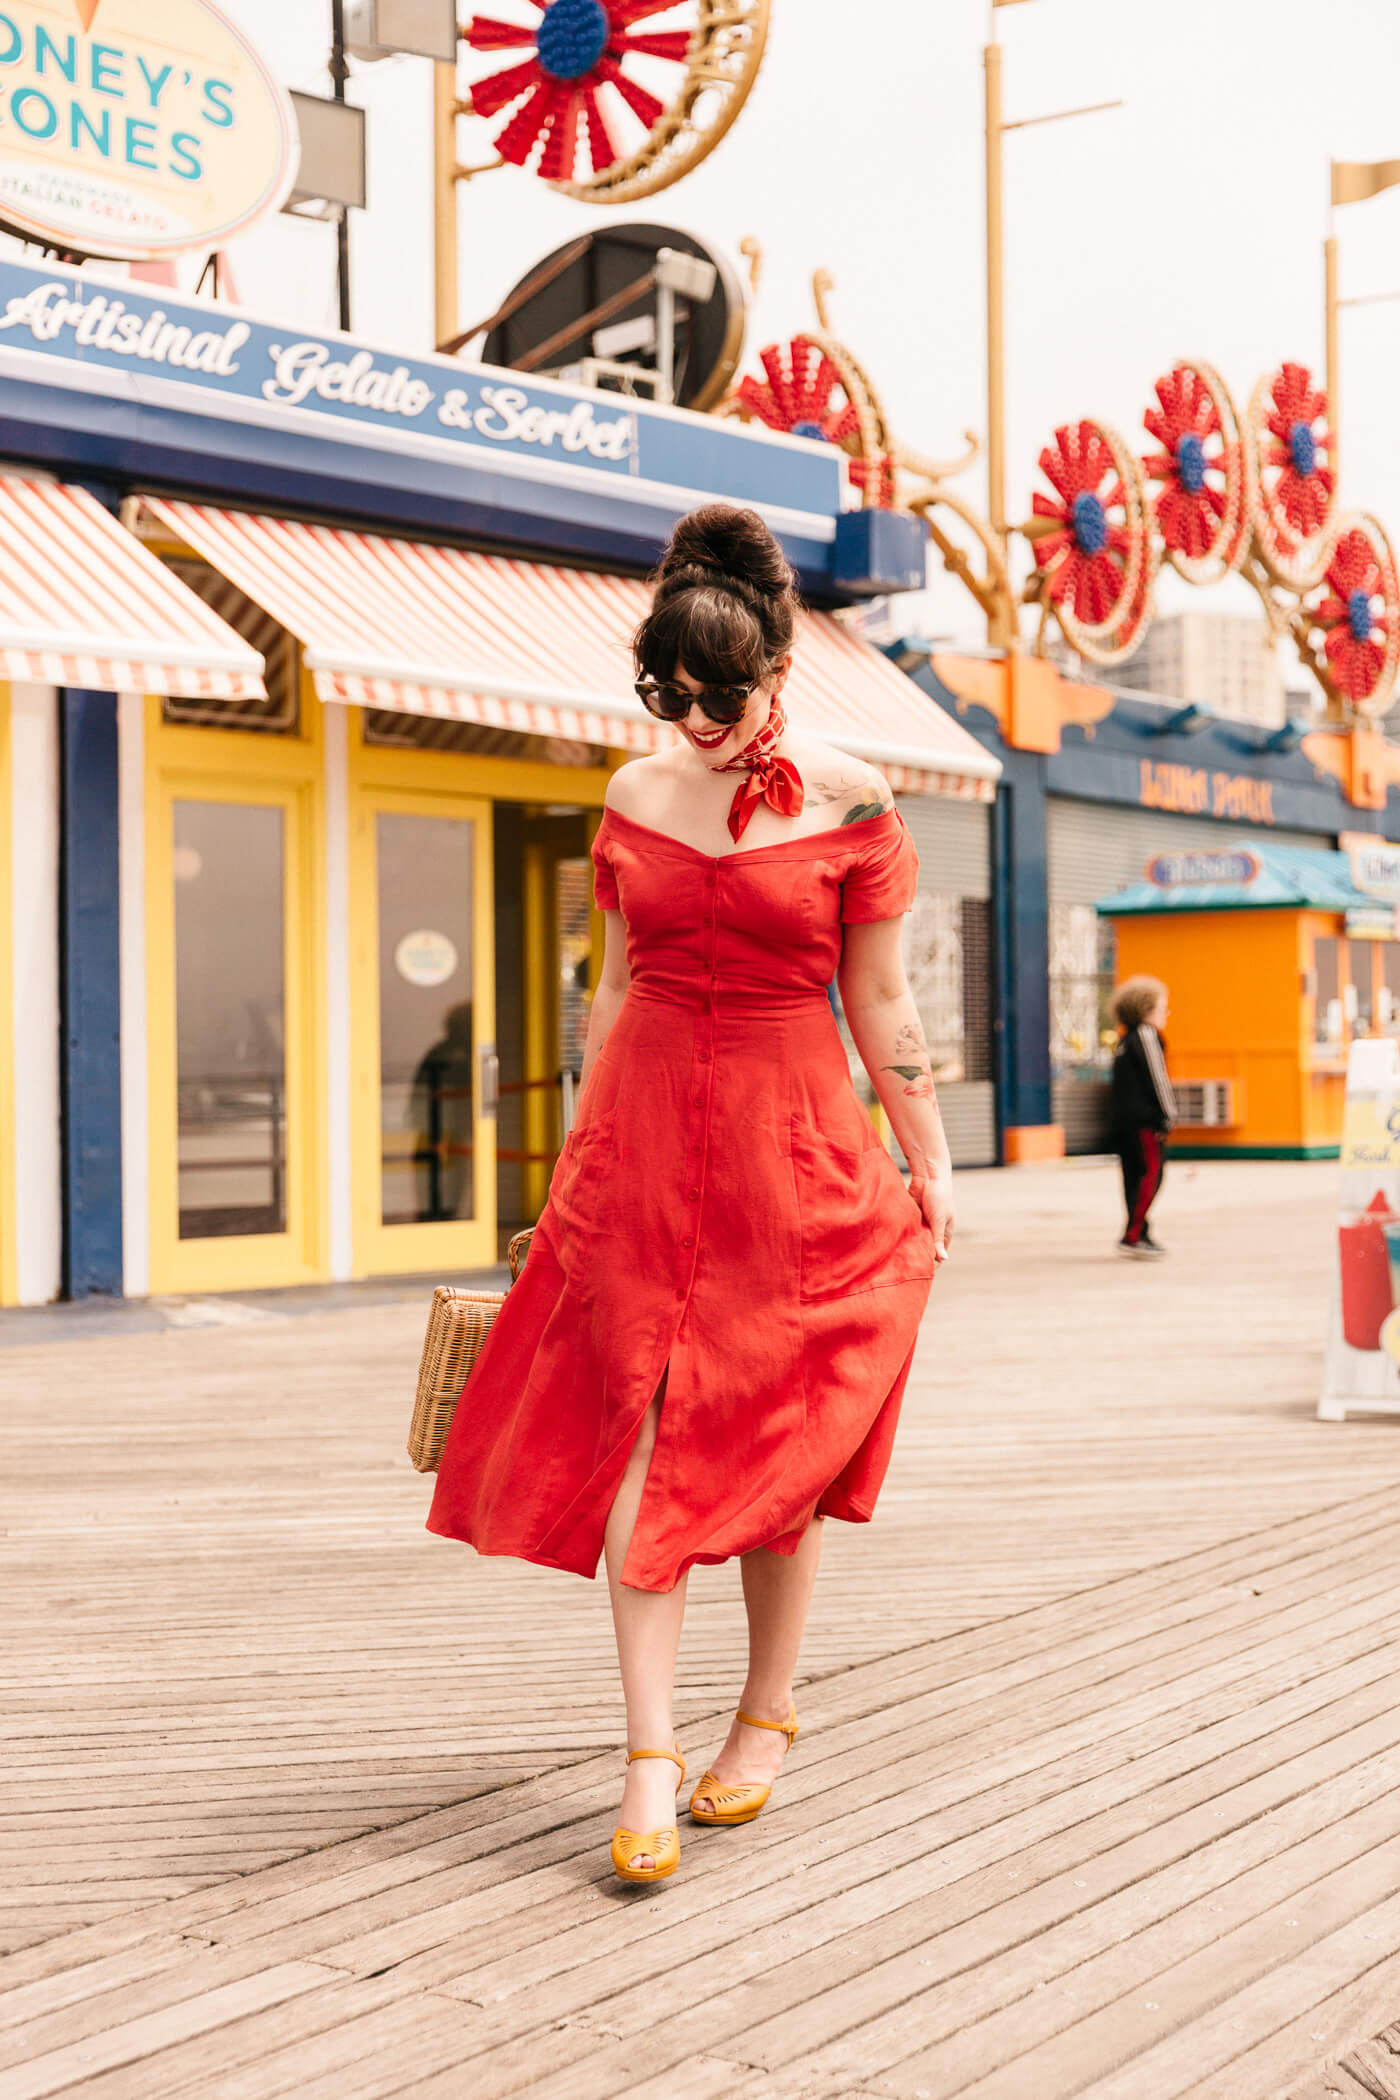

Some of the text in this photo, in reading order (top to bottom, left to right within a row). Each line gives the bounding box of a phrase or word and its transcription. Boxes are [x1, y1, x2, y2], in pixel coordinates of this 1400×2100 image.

[0, 82, 203, 181] ONES
[89, 199, 169, 231] GELATO
[0, 282, 634, 462] Artisinal Gelato & Sorbet
